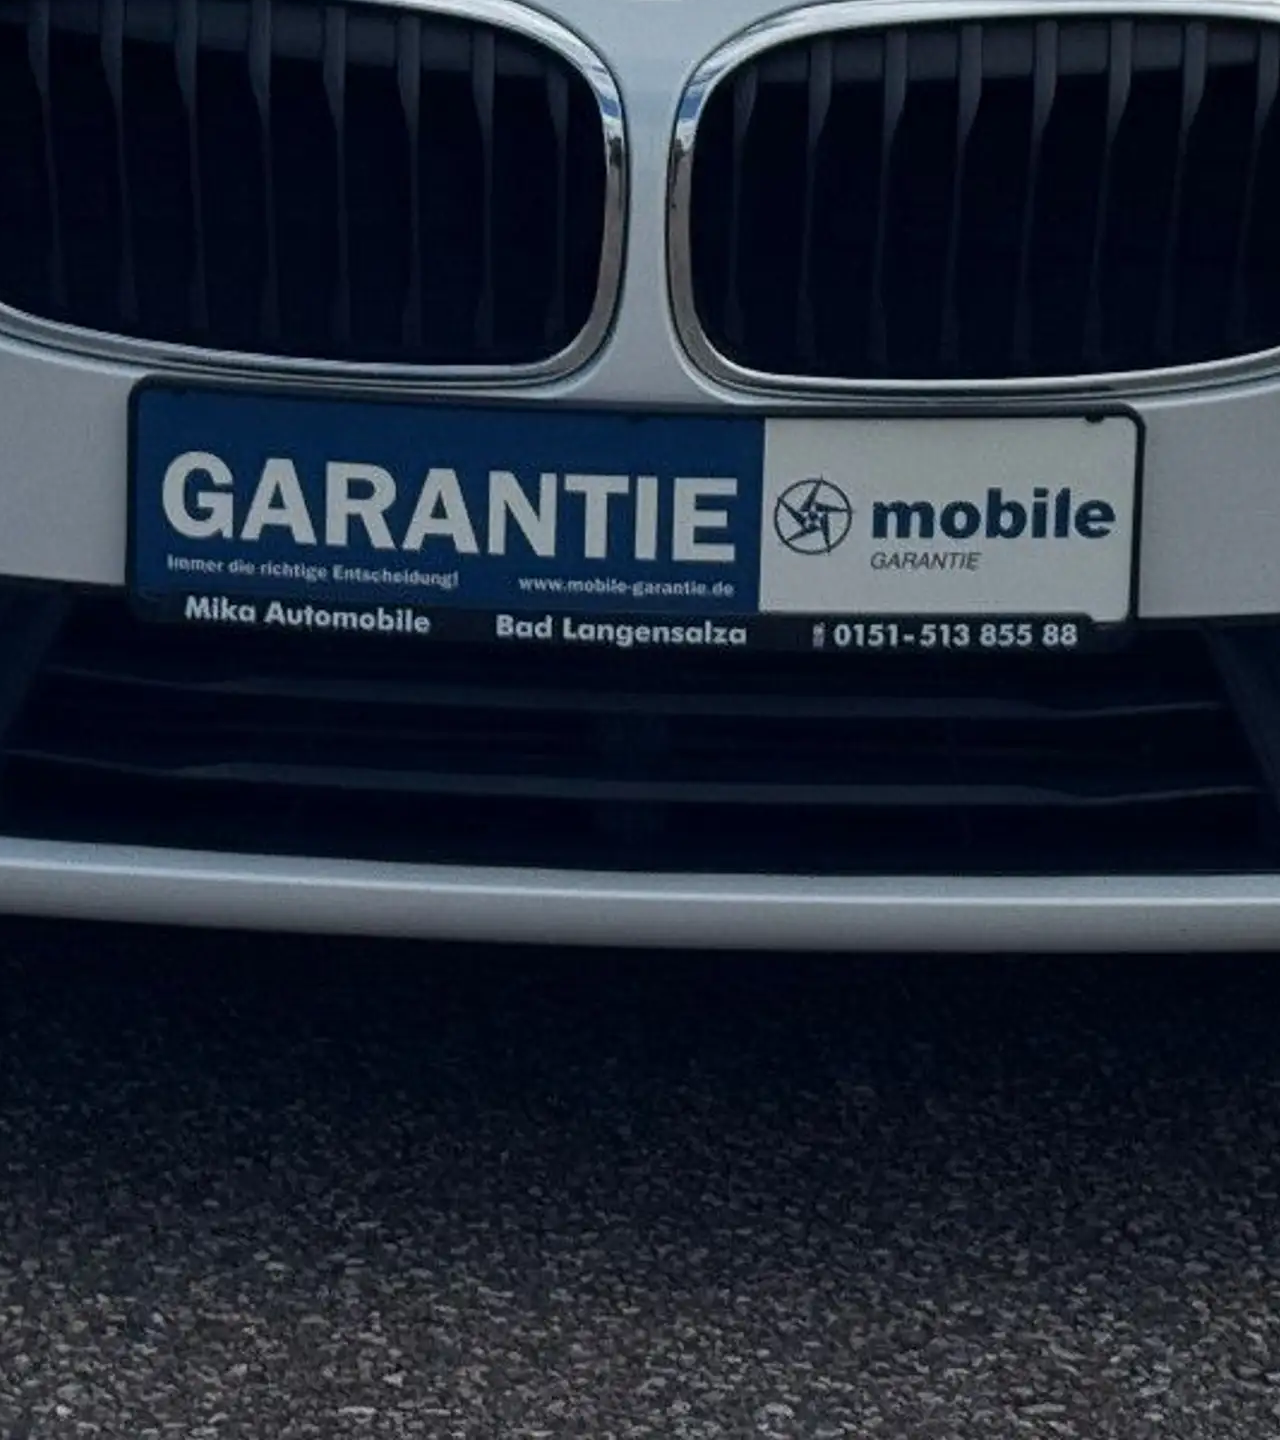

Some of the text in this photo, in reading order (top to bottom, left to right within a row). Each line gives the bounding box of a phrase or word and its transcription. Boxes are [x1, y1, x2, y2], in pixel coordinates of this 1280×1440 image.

[161, 450, 737, 563] GARANTIE
[872, 486, 1117, 540] mobile
[167, 553, 460, 590] Immer die richtige Entscheidung!
[870, 551, 983, 572] GARANTIE
[519, 576, 735, 597] www.mobile-garantie.de
[185, 595, 432, 634] Mika Automobile
[495, 613, 748, 648] Bad Langensalza
[979, 623, 1033, 648] 855
[1042, 623, 1079, 648] 88
